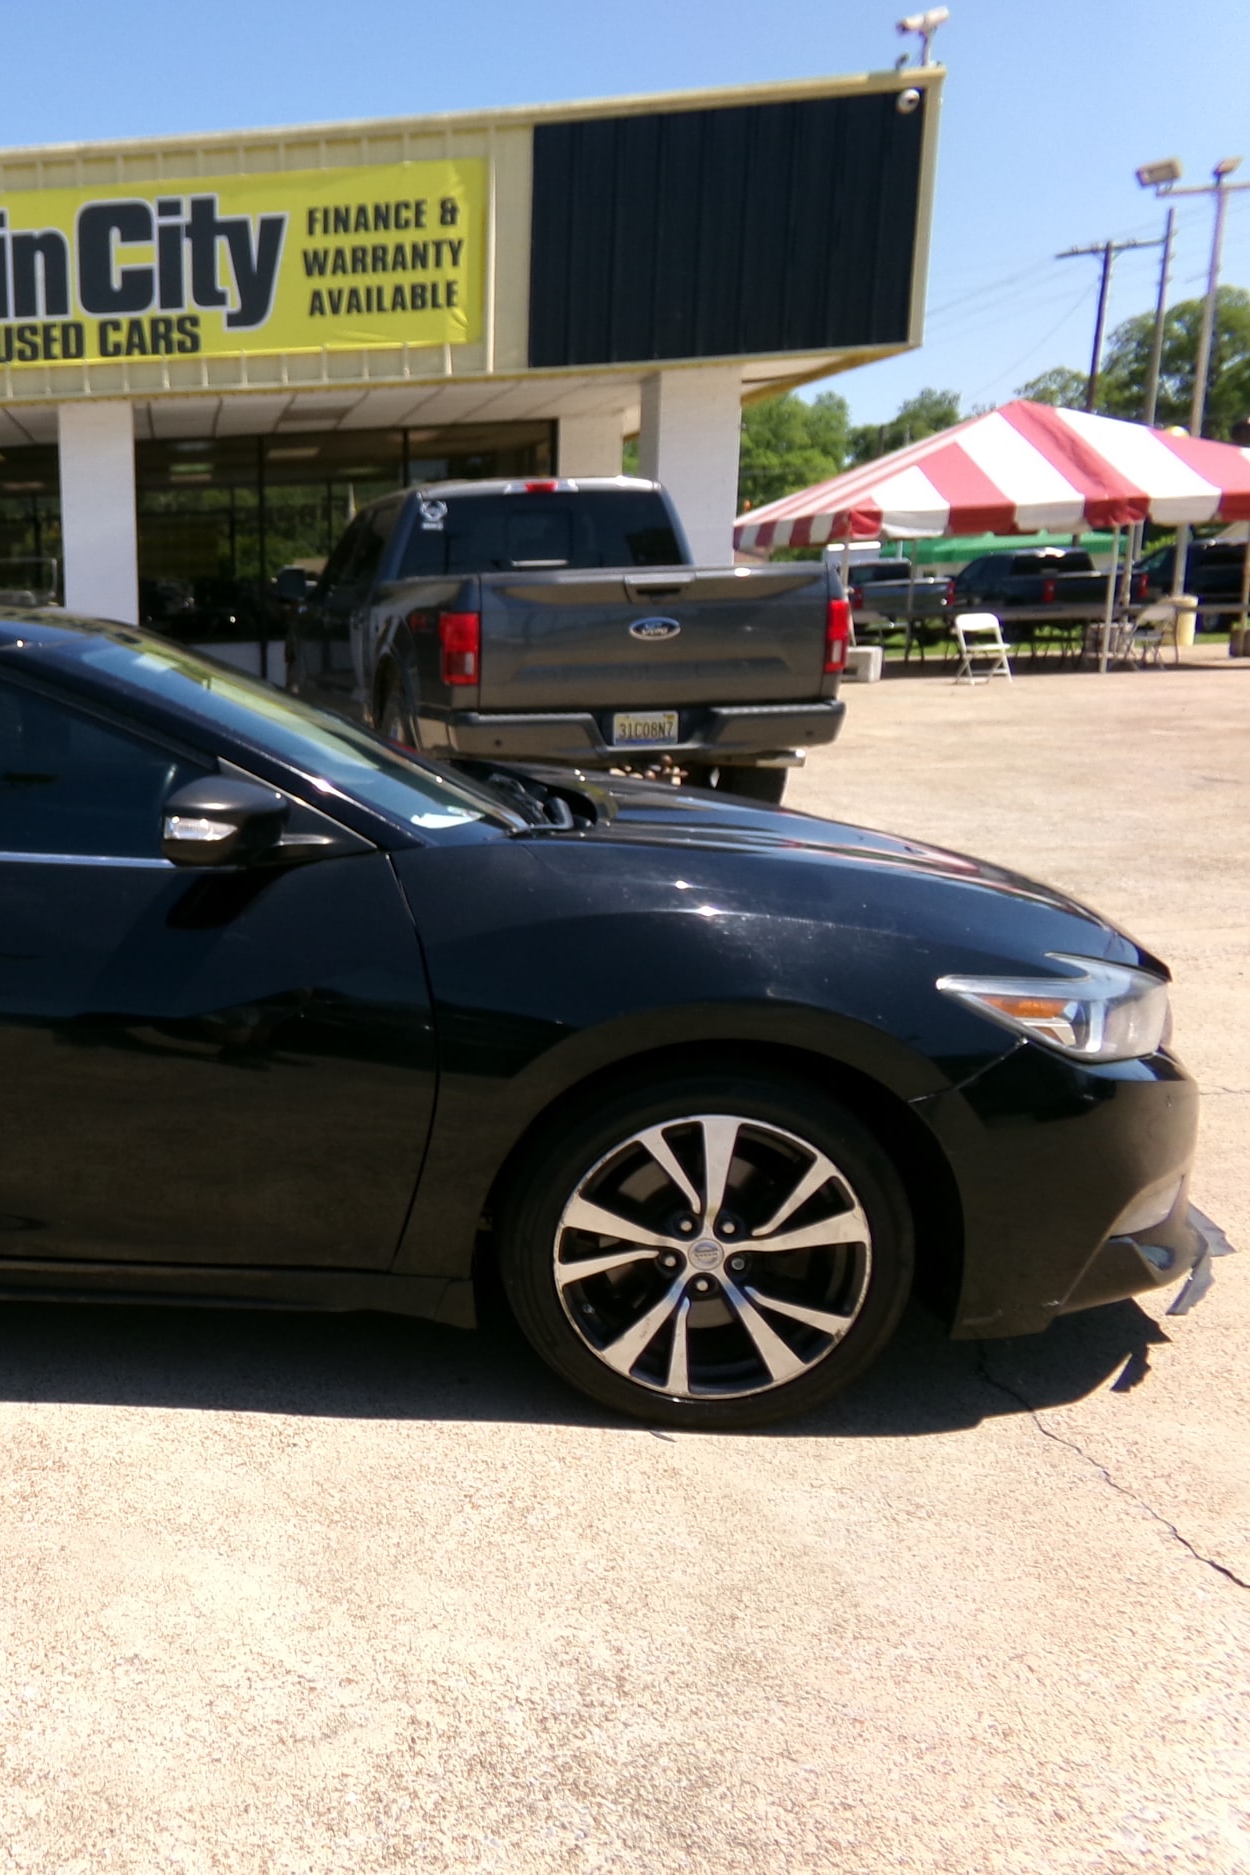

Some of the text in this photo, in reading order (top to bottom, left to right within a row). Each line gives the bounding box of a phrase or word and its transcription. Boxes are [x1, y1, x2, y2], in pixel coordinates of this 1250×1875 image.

[307, 196, 460, 236] FINANCE &
[303, 239, 464, 278] WARRANTY
[308, 280, 459, 318] AVAILABLE
[98, 314, 201, 357] CARS
